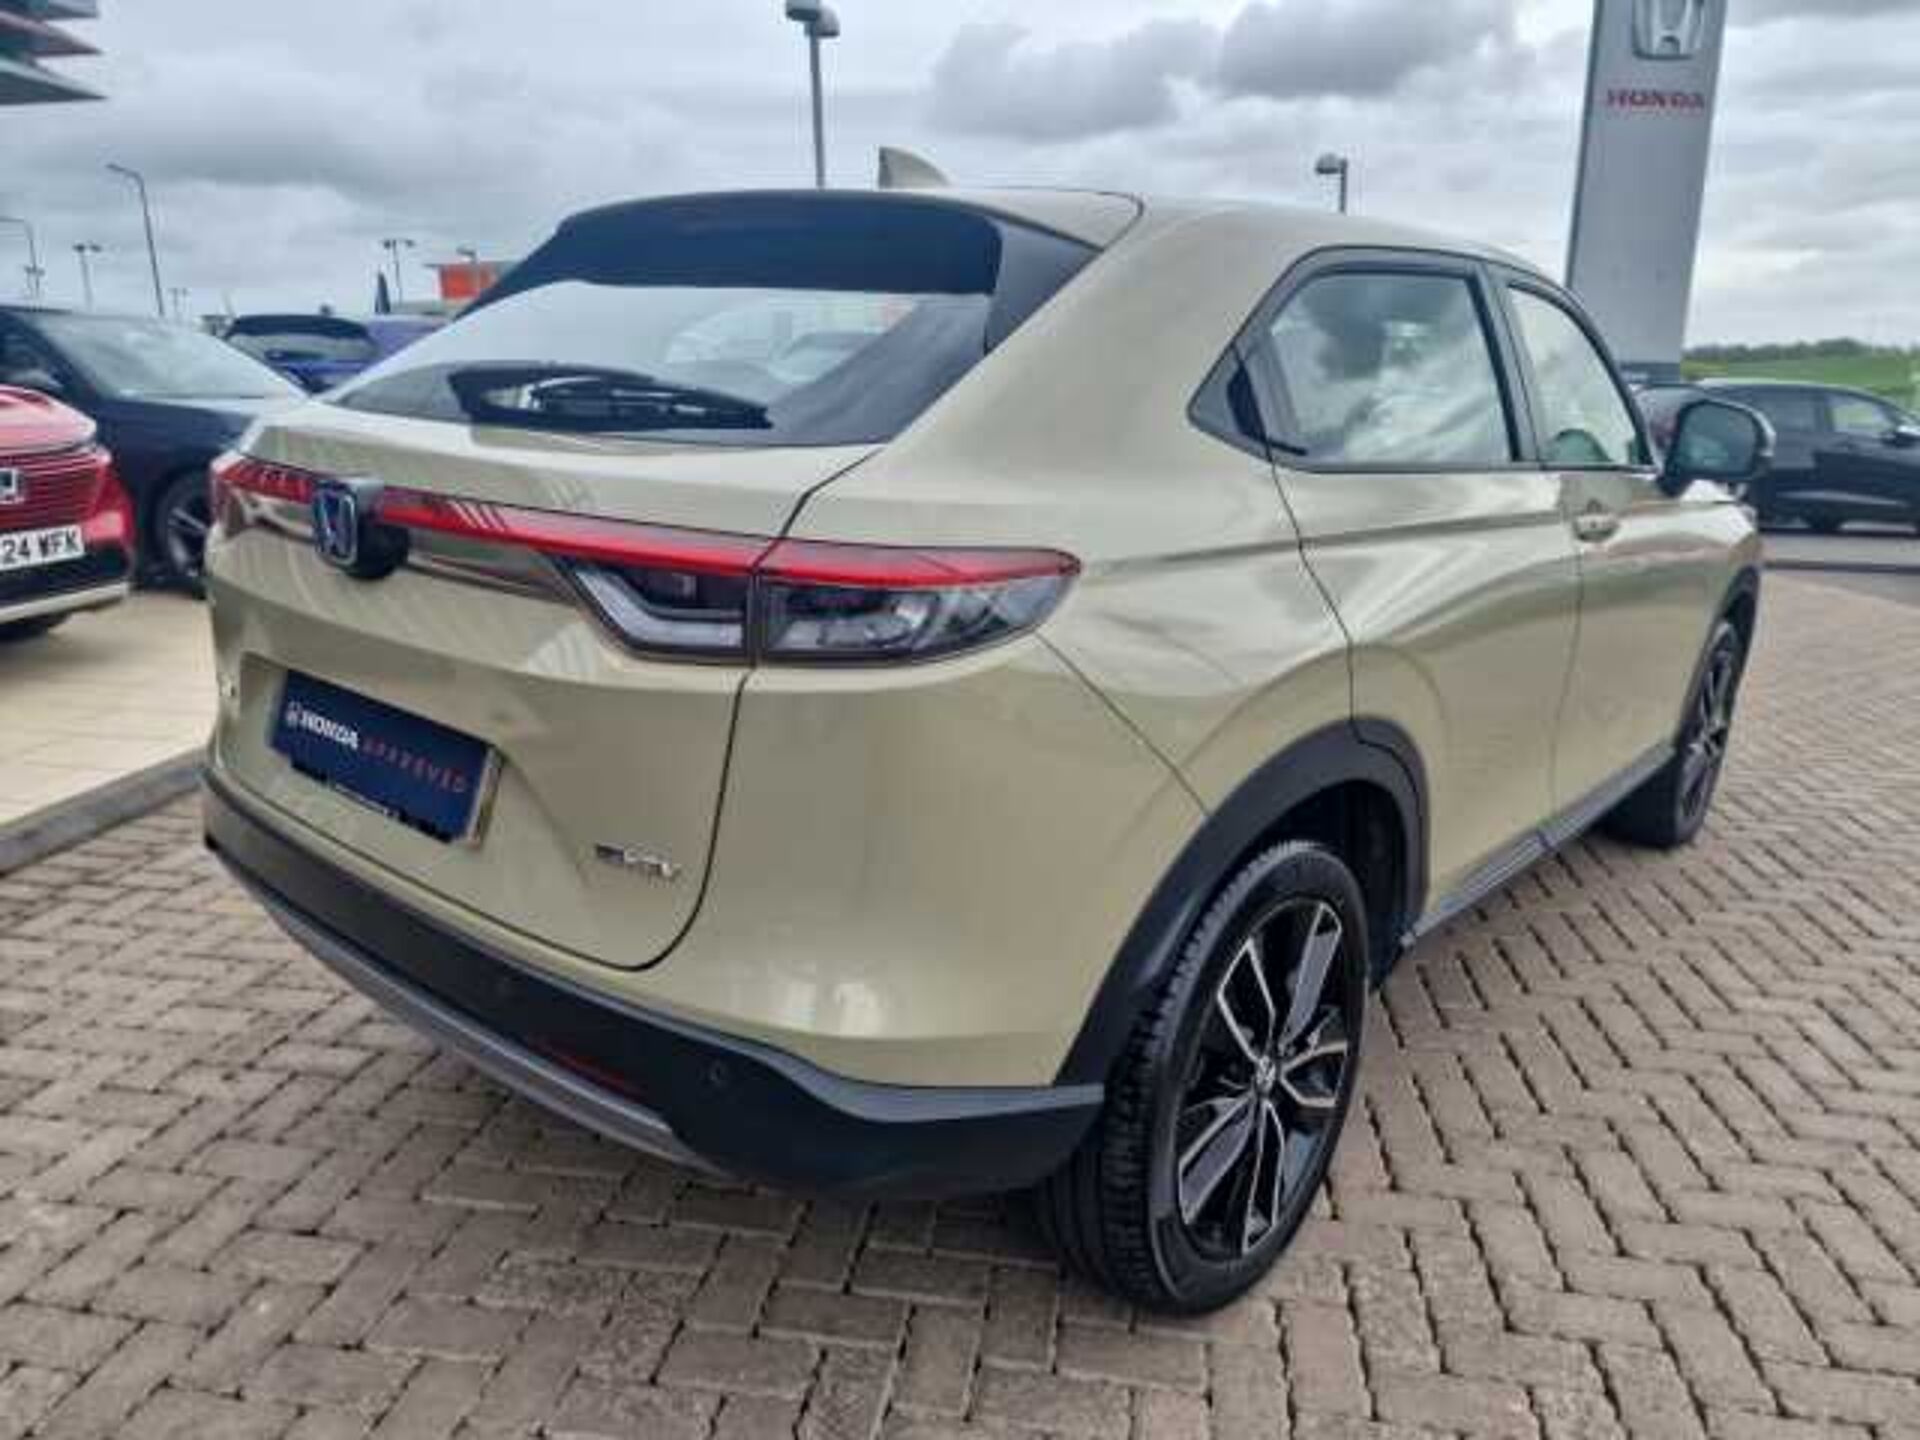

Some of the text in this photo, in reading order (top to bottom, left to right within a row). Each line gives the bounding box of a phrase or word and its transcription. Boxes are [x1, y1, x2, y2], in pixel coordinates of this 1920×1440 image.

[1606, 88, 1705, 109] HONDA
[1, 538, 31, 564] 24
[299, 710, 360, 750] HONDA
